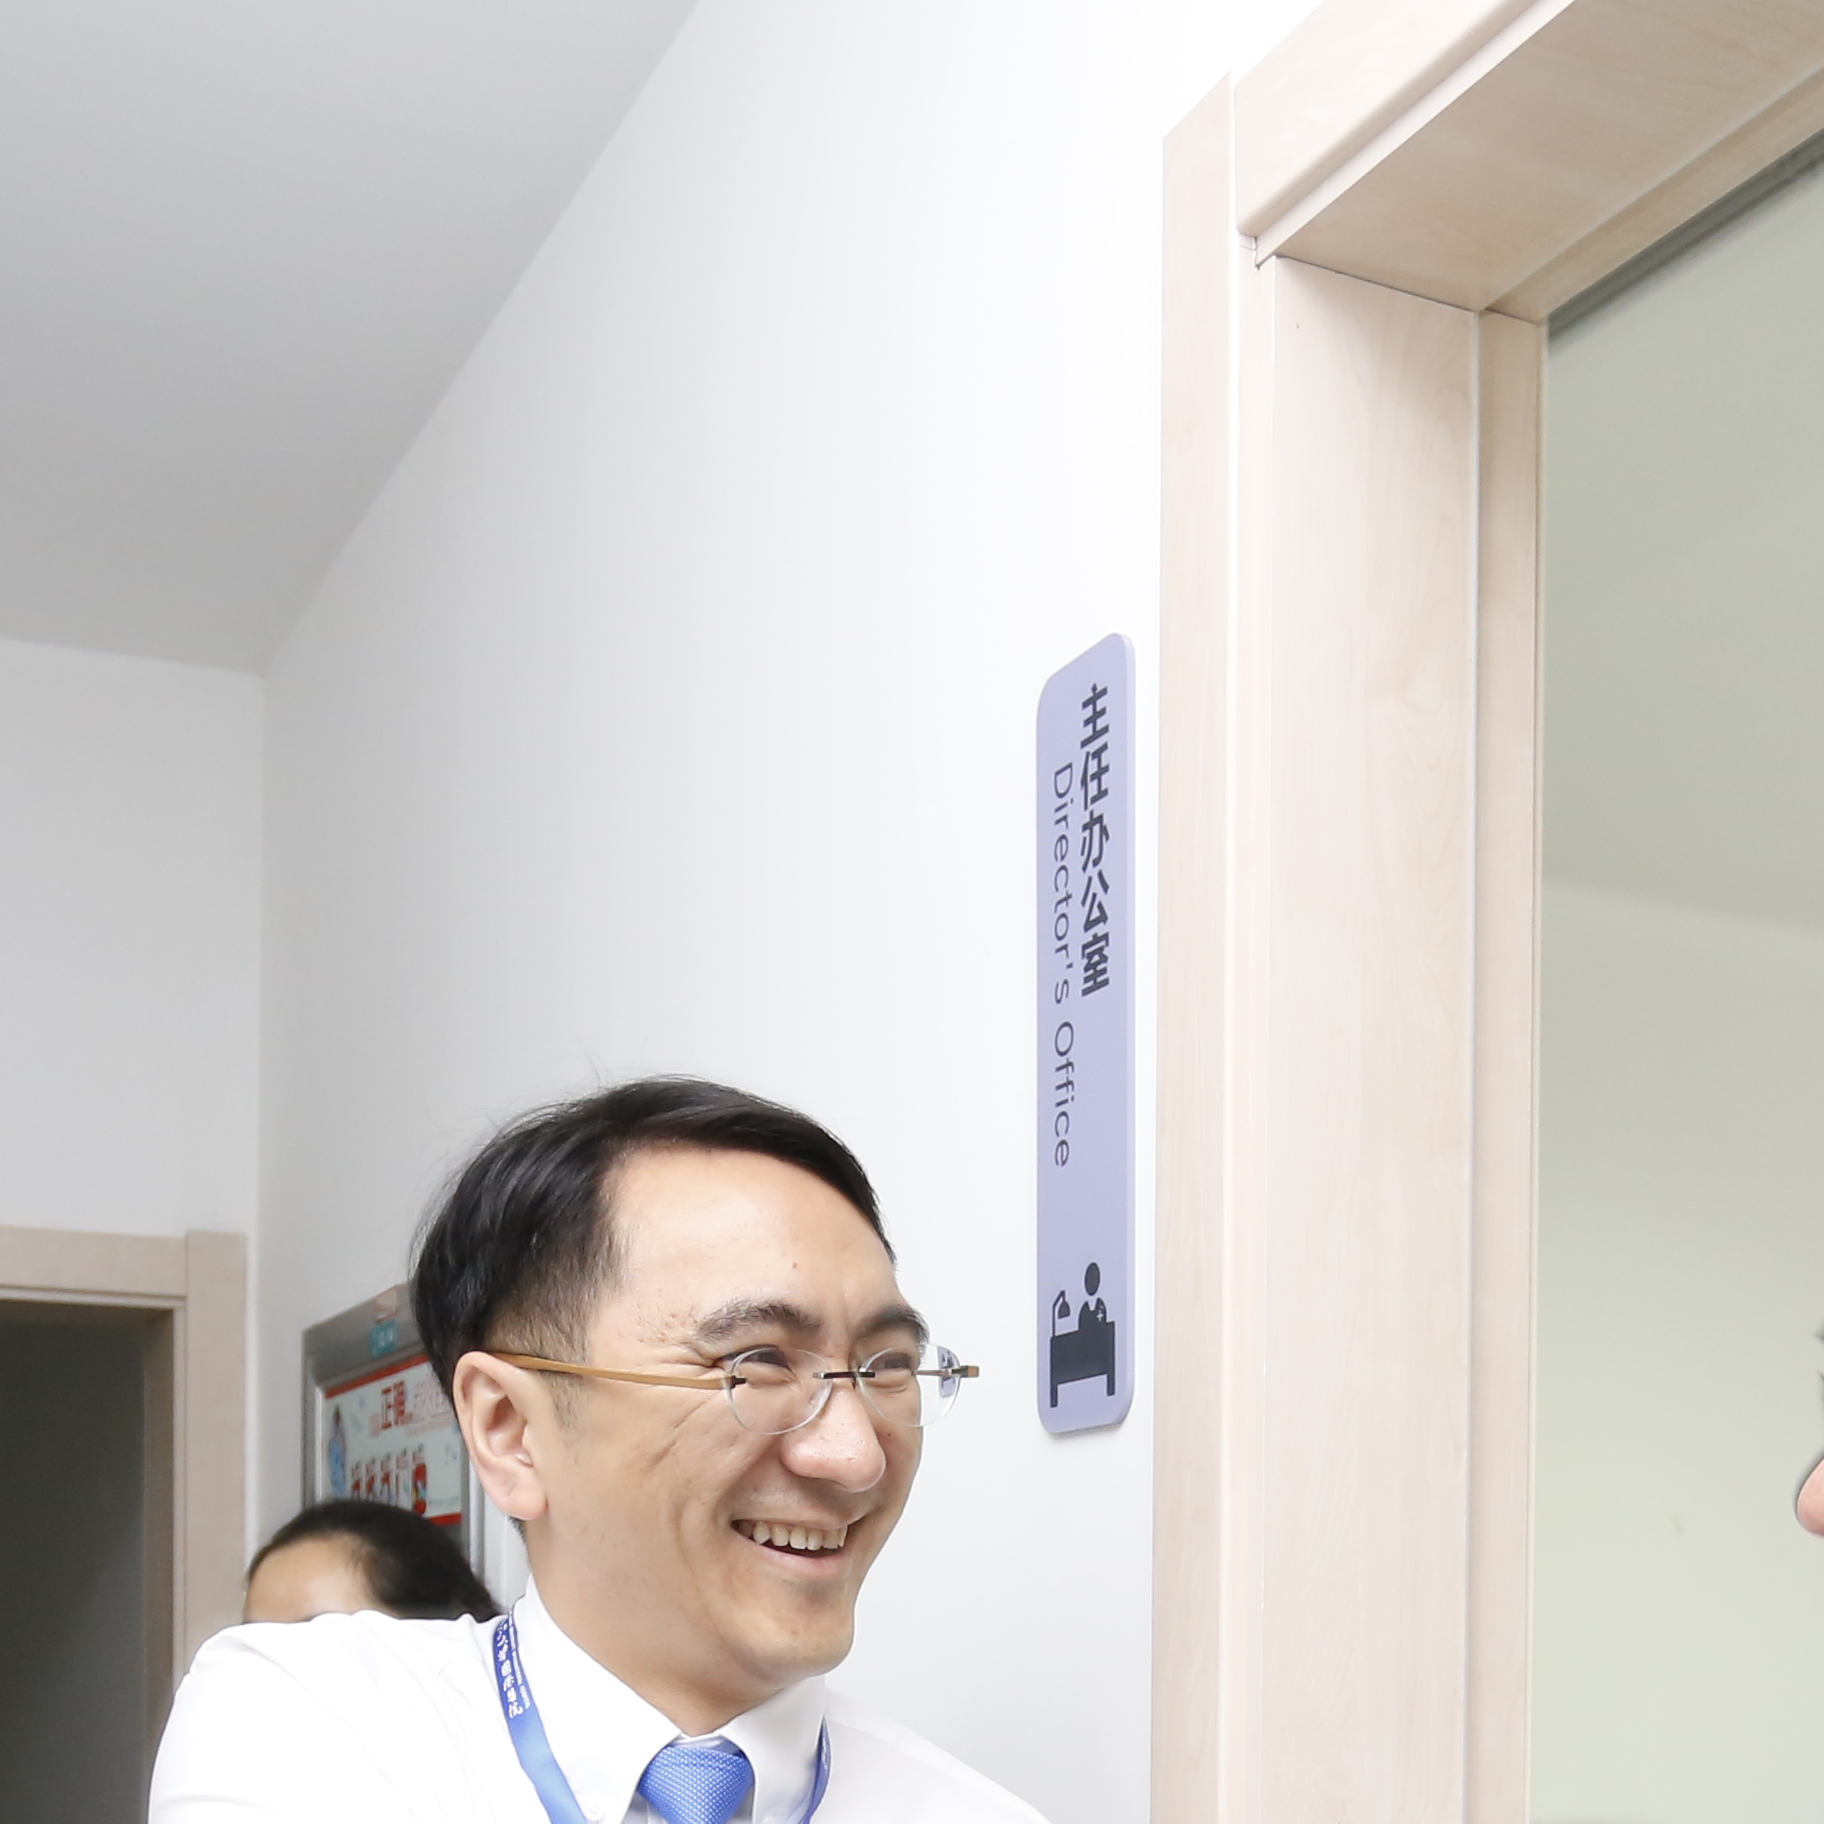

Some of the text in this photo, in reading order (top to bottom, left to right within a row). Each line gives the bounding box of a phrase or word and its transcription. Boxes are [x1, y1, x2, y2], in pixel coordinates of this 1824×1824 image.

[1054, 761, 1075, 1167] Director's Office
[1080, 682, 1110, 997] 主任办公室
